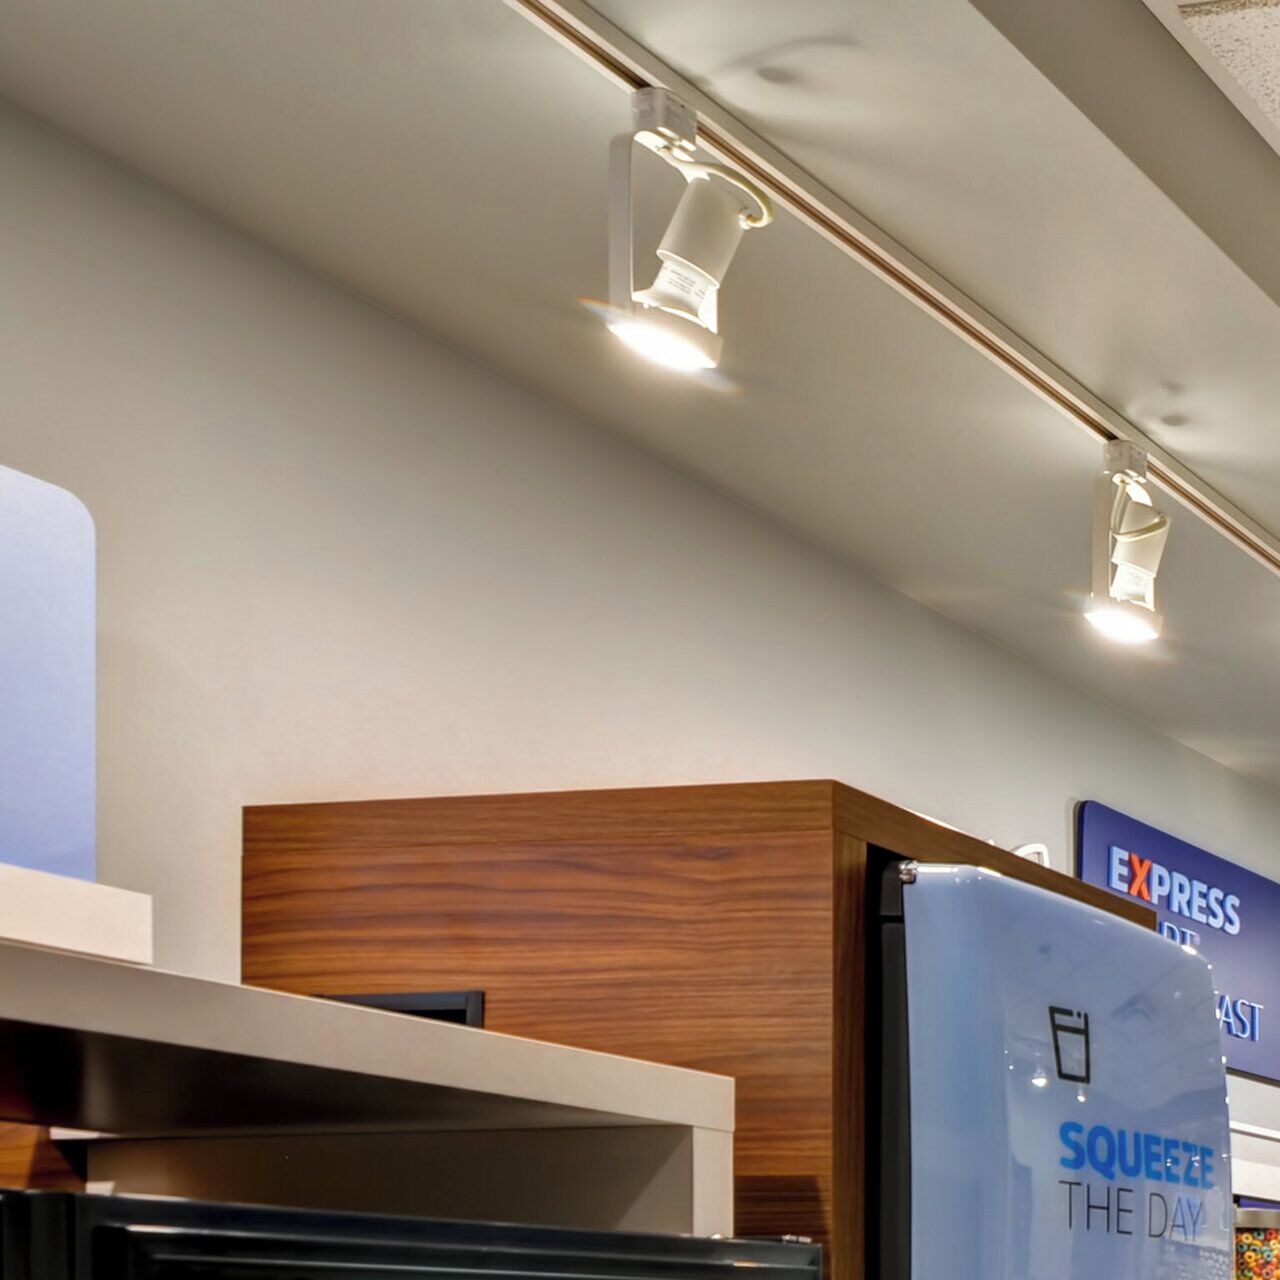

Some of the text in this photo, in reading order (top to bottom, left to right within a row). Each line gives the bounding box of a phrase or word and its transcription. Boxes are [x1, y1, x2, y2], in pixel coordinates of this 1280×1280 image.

[1109, 845, 1240, 935] EXPRESS
[1059, 1121, 1214, 1189] SQUEEZE
[1059, 1180, 1204, 1242] THE DAY
